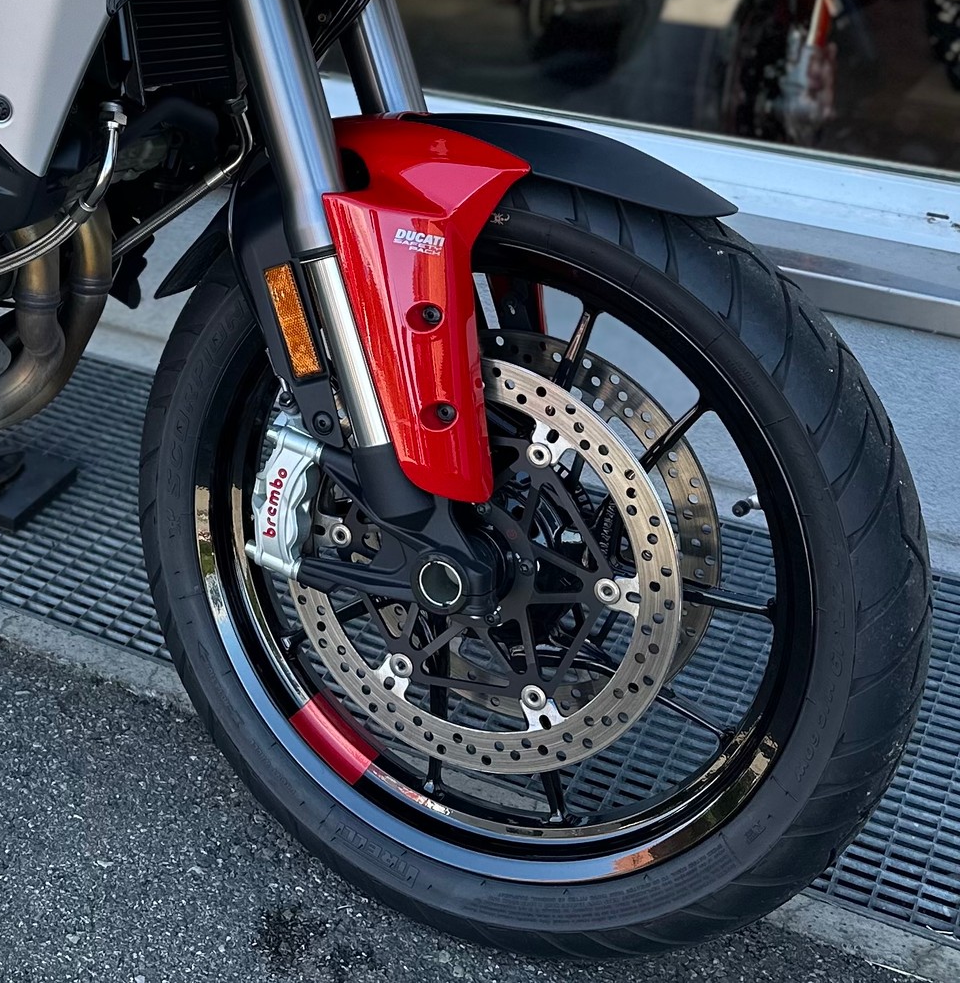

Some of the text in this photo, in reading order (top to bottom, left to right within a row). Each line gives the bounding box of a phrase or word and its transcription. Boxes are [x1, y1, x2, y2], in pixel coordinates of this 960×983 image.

[393, 238, 443, 251] SAFETY
[395, 228, 445, 247] DUCATI
[409, 246, 441, 256] PACK
[167, 300, 245, 495] SCORPION
[261, 467, 288, 538] brembo
[335, 821, 421, 889] PIRELLI
